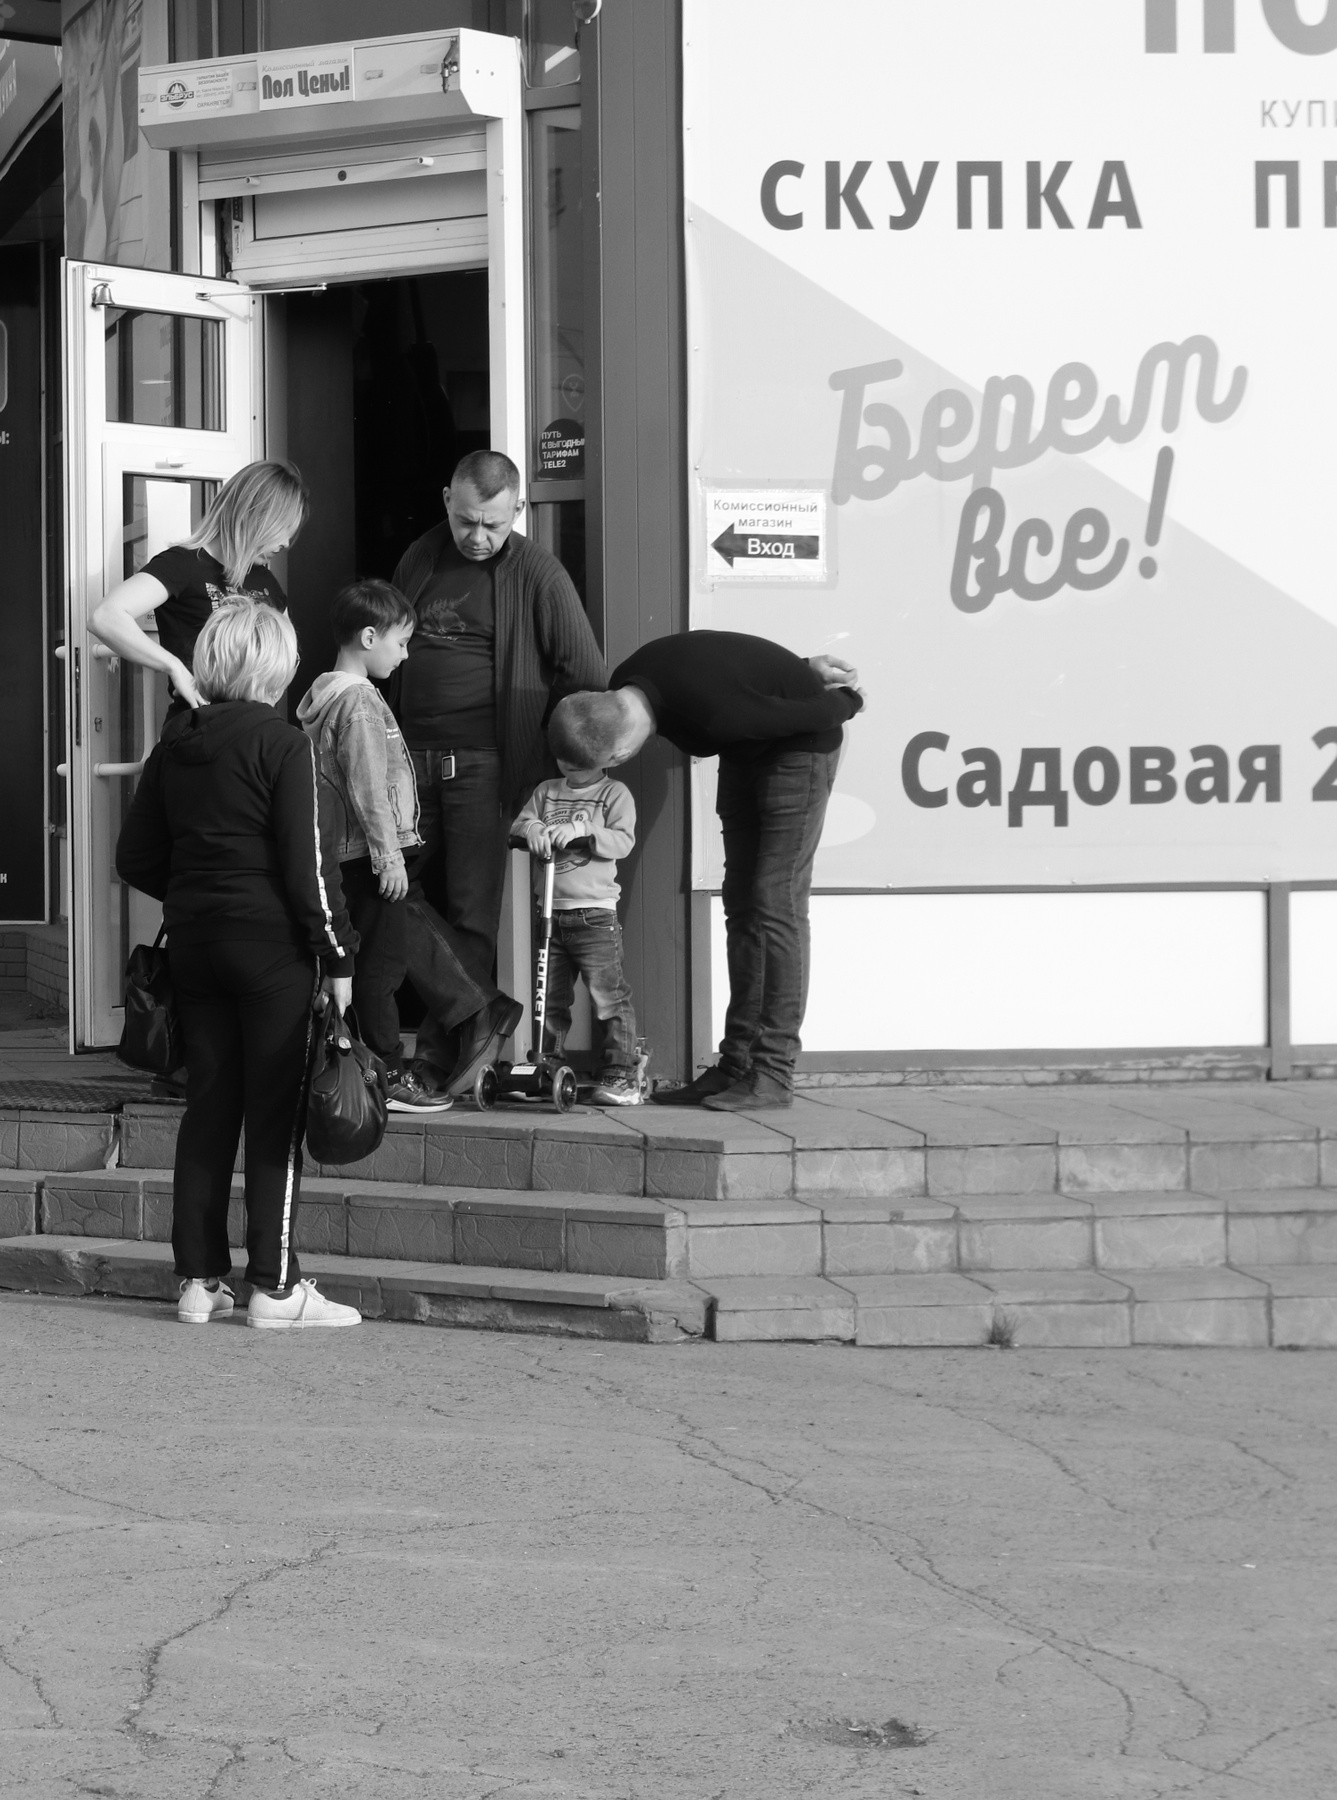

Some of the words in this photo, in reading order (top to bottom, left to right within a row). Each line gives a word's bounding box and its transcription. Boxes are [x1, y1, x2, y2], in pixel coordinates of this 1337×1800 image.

[262, 74, 295, 100] Пол
[298, 65, 350, 97] Цены!
[1261, 99, 1337, 128] КУП
[760, 160, 1143, 231] СКУПКА
[541, 431, 562, 439] ПУТЬ
[542, 449, 579, 459] ТАРИФАМ
[543, 460, 567, 469] TELE2
[713, 499, 818, 513] Комиссионный
[738, 518, 793, 528] магазин
[747, 538, 795, 559] Вход
[901, 731, 1282, 828] Садовая
[534, 948, 548, 1025] ROCKET
